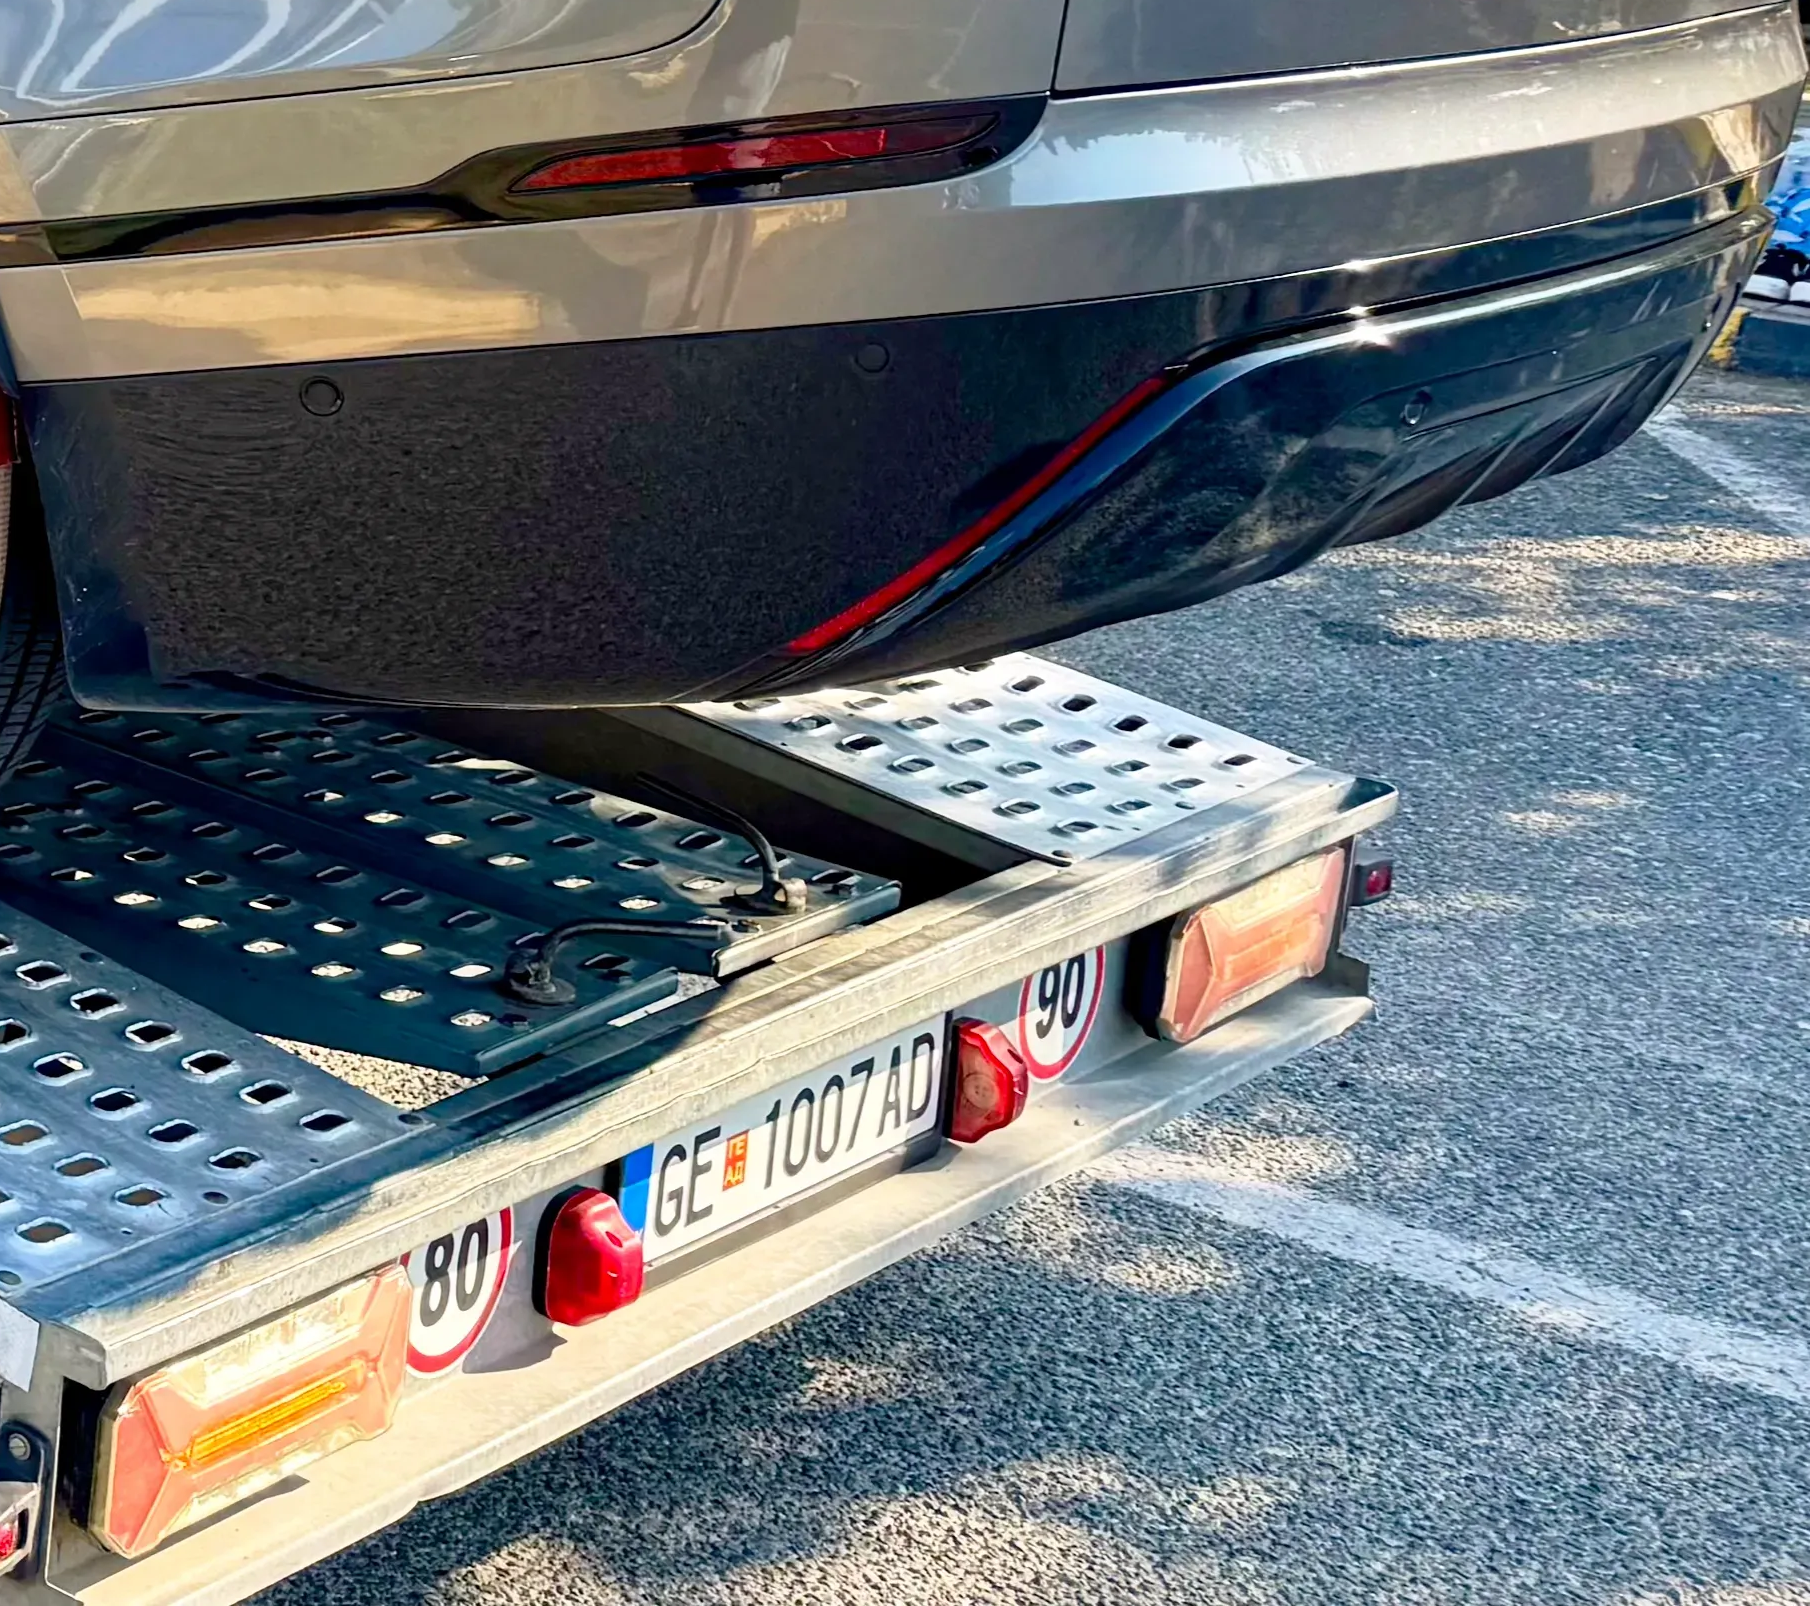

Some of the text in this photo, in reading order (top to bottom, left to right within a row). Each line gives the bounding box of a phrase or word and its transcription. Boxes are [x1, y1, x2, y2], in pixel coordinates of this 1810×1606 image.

[1036, 953, 1086, 1039] 90
[654, 1125, 721, 1237] GE
[420, 1218, 489, 1328] 80
